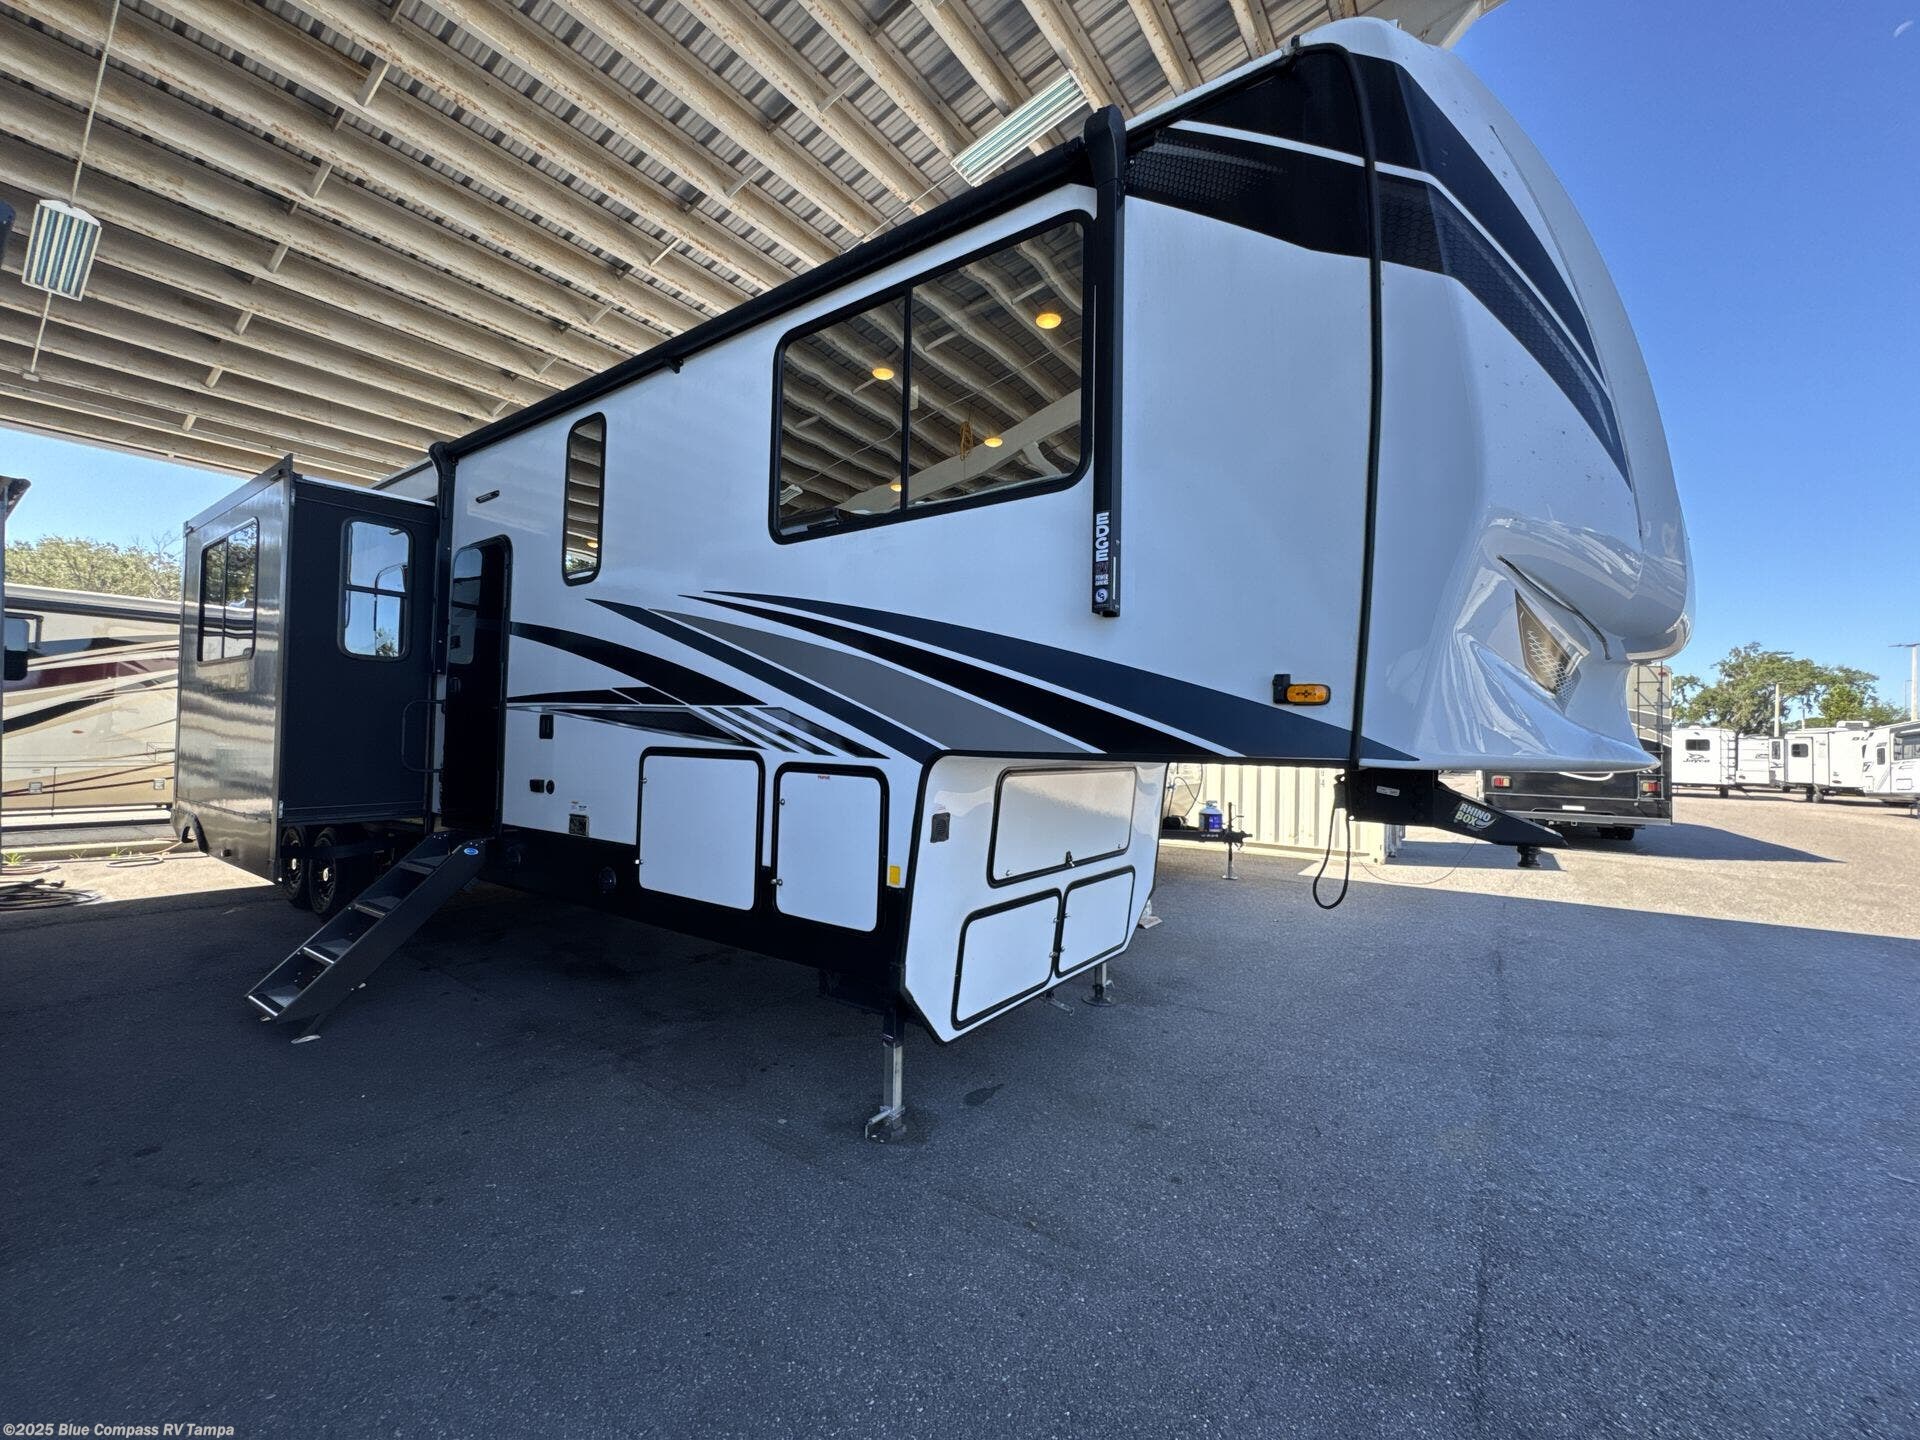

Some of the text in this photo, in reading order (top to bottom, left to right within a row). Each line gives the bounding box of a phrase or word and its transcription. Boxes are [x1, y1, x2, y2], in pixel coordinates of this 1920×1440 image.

[1095, 512, 1109, 562] EDGE
[1455, 811, 1477, 826] BOX
[1459, 803, 1491, 821] RHINO
